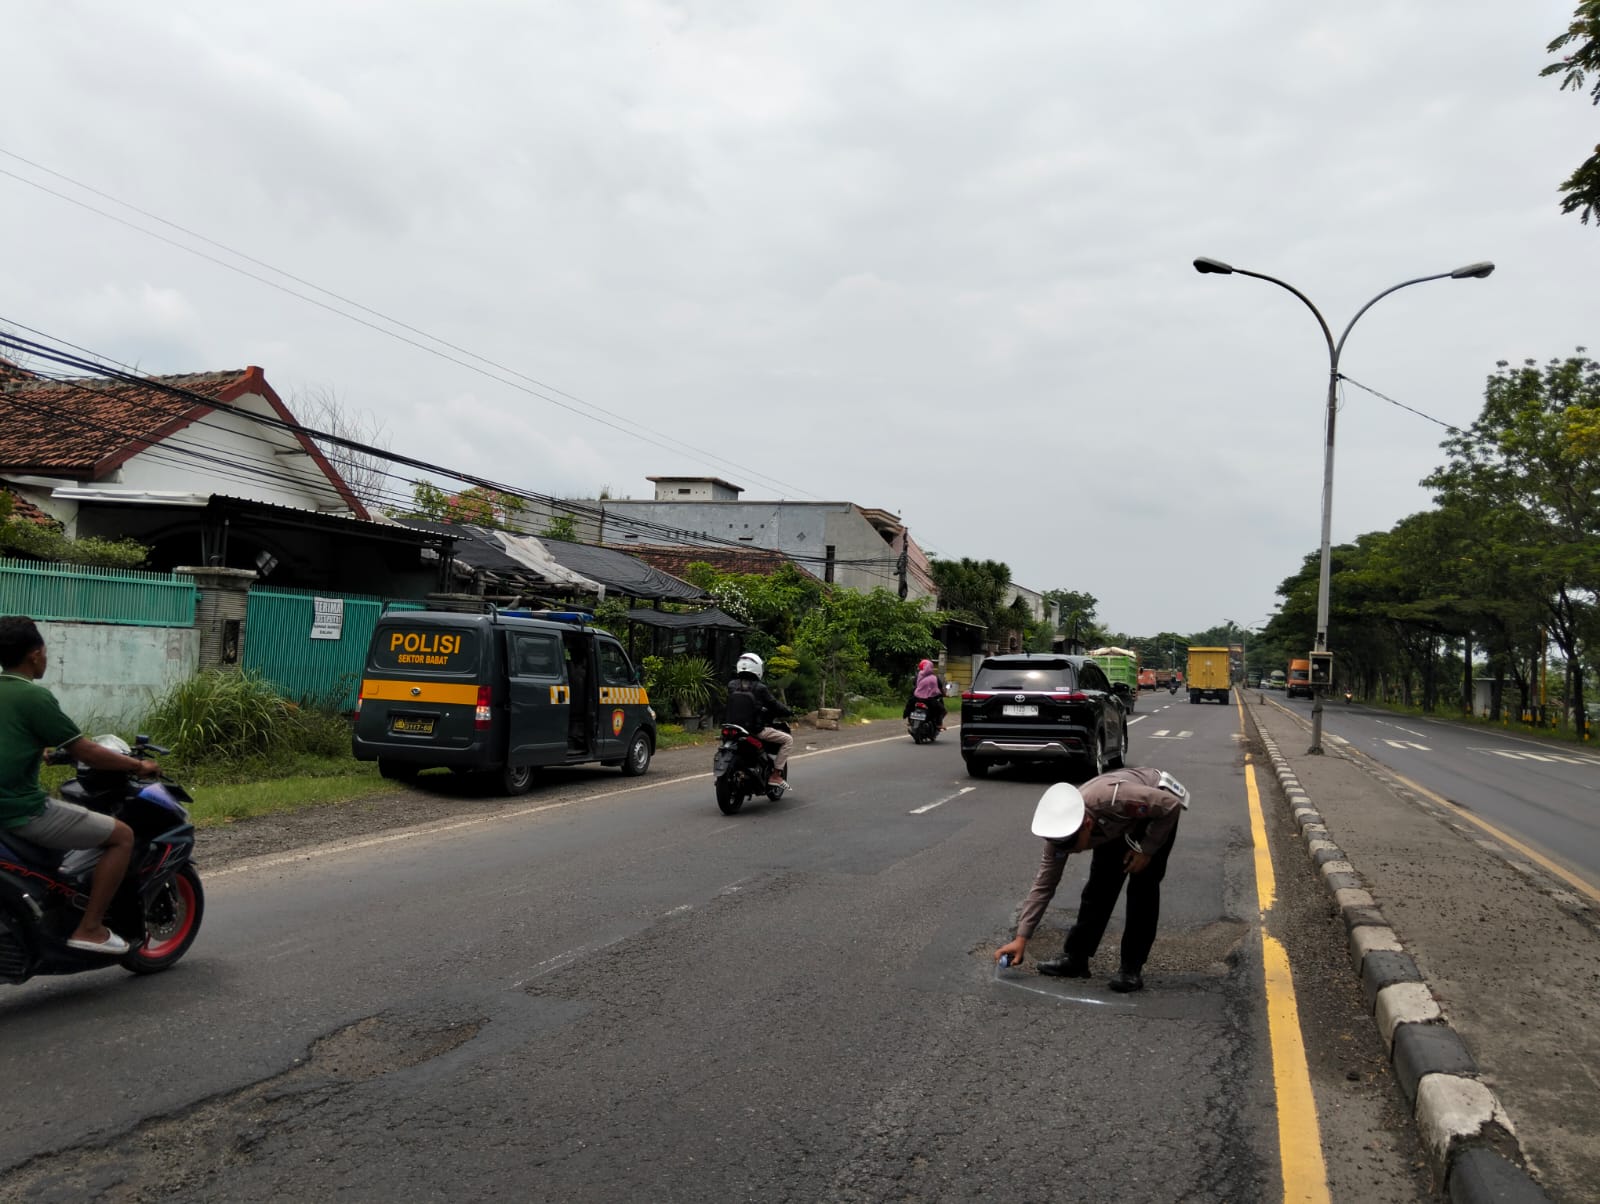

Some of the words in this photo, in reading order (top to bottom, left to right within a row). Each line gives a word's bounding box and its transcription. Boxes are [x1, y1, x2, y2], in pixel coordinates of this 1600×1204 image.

[315, 601, 342, 614] TERIMA
[390, 633, 461, 654] POLISI
[398, 654, 425, 664] SEKTOR
[425, 655, 449, 665] BABAT
